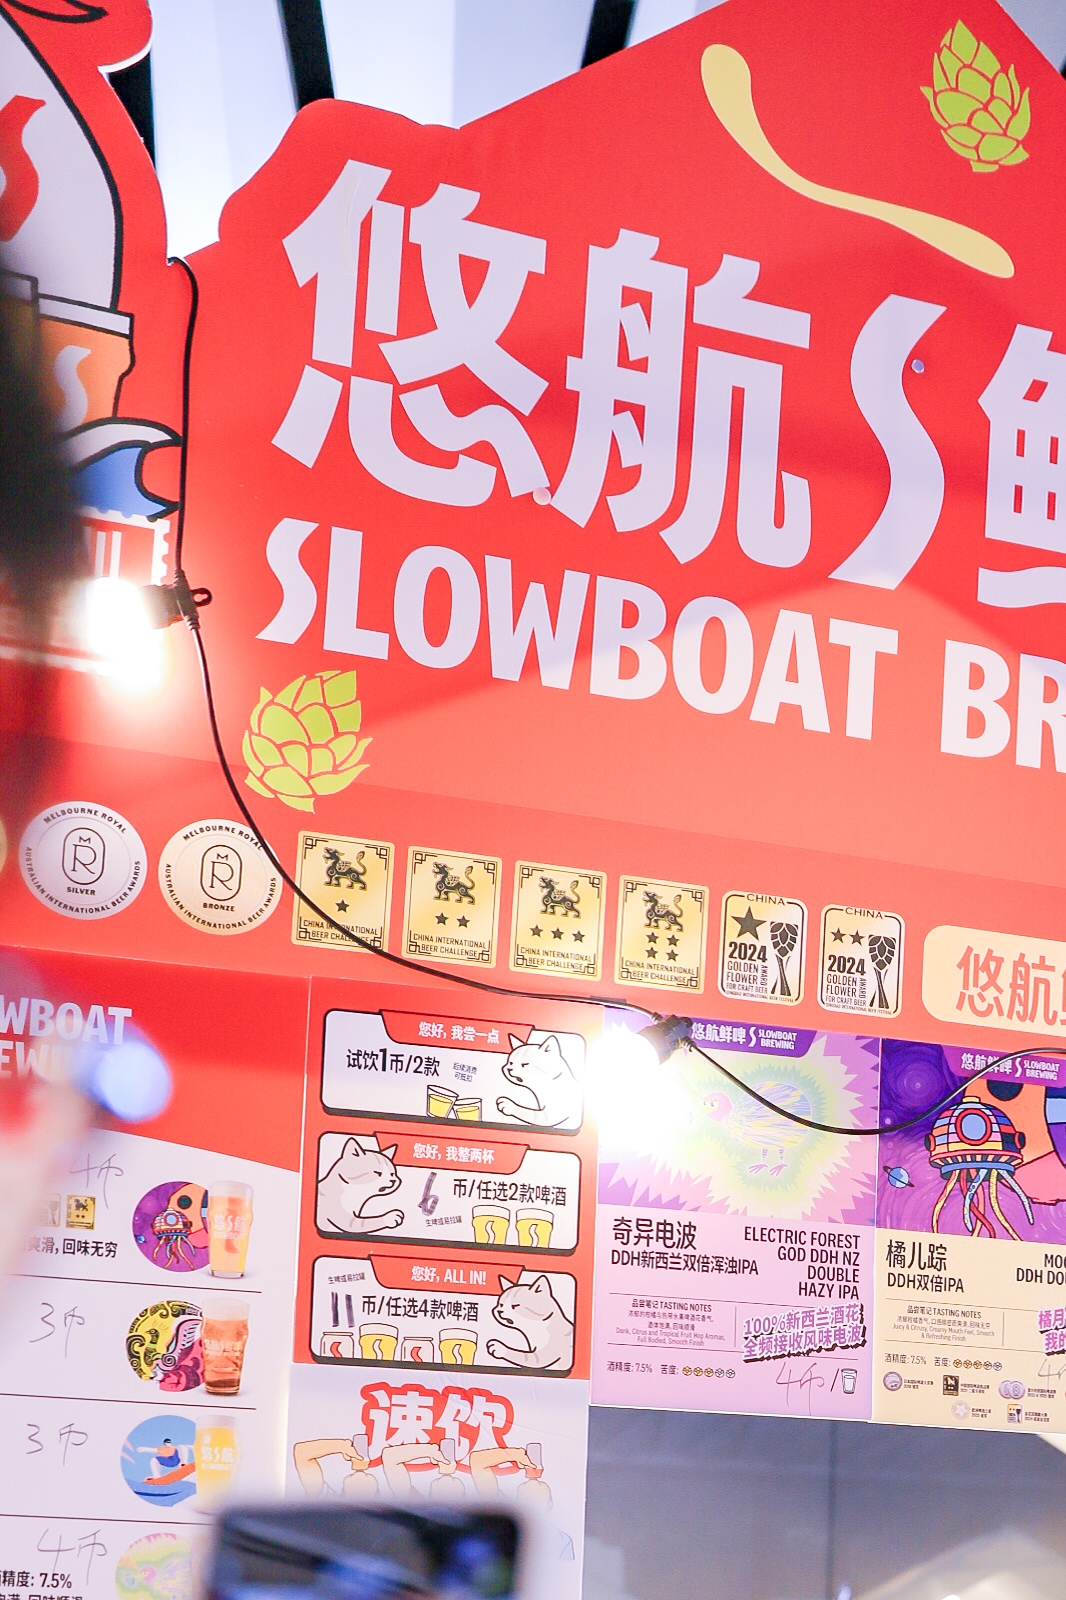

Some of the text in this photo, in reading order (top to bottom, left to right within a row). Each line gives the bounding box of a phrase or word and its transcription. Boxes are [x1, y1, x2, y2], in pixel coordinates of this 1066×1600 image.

[272, 159, 812, 567] 悠航
[256, 516, 898, 740] SLOWBOAT
[102, 813, 127, 834] ROYAL
[67, 886, 96, 896] SILVER
[746, 893, 785, 906] CHINA
[202, 902, 235, 912] BRONZE
[844, 907, 884, 920] CHINA
[413, 933, 487, 950] CHINA INTERNATIONAL
[421, 944, 478, 958] BEER CHALLENGE
[520, 946, 593, 963] CHINA INTERNATIONAL
[728, 941, 768, 963] 2024
[547, 959, 584, 972] CHALLENGE
[647, 963, 696, 976] INTERNATIONAL
[727, 960, 759, 974] GOLDEN
[827, 954, 866, 976] 2024
[650, 973, 687, 985] CHALLENGE
[726, 972, 758, 985] FLOWER
[826, 973, 858, 987] GOLDEN
[825, 985, 857, 998] FLOWER
[691, 1021, 798, 1045] 悠航鲜啤 SLOWBOAT
[760, 1039, 795, 1050] BREWING
[346, 1048, 441, 1077] 试饮1币/2款
[1023, 1059, 1061, 1073] SLOWBOAT
[1025, 1069, 1059, 1082] BREWING
[453, 1178, 567, 1207] 币/任选2款啤酒
[613, 1217, 697, 1250] 奇异电波
[744, 1226, 861, 1250] ELECTRIC FOREST
[611, 1249, 759, 1275] DDH新西兰双倍浑浊IPA
[777, 1246, 860, 1266] GOD DDH NZ
[886, 1239, 948, 1272] 橘儿踪
[443, 1270, 466, 1284] ALL
[469, 1271, 487, 1286] IN!
[807, 1265, 860, 1283] DOUBLE
[1016, 1267, 1043, 1284] DDH
[798, 1282, 860, 1300] HAZY IPA
[887, 1272, 965, 1294] DDH双倍IPA
[361, 1294, 480, 1322] 币/任选4款啤酒
[364, 1386, 512, 1470] 速饮
[40, 1572, 73, 1589] 7.5%
